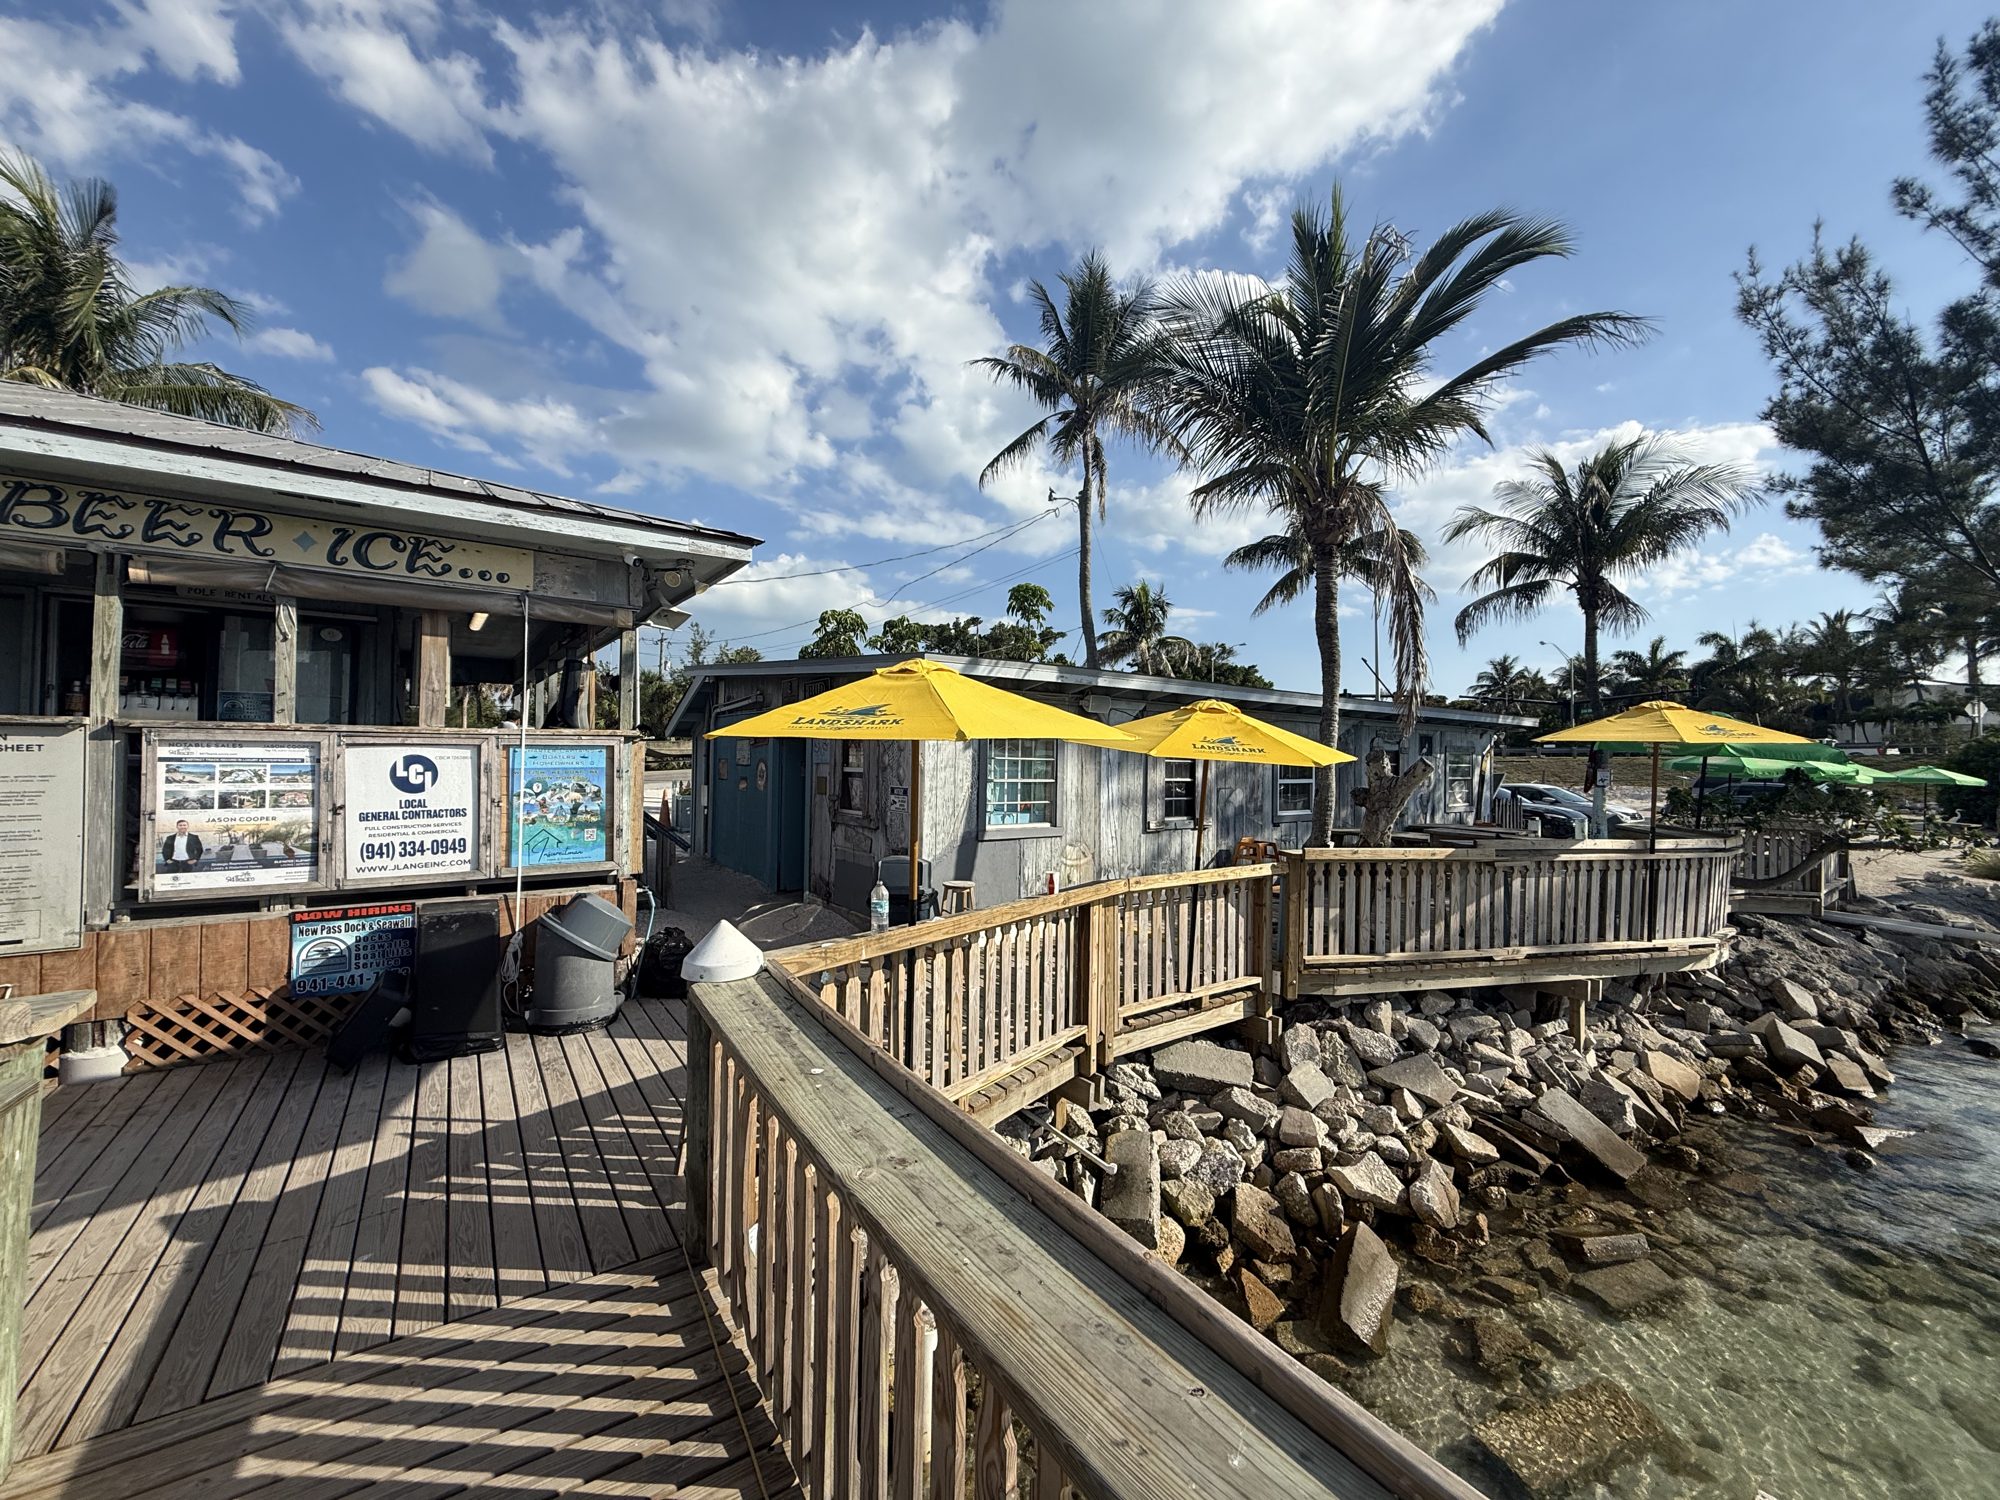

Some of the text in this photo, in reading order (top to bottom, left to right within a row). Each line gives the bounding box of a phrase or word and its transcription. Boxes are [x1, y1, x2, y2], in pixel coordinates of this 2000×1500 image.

[0, 480, 275, 557] BEER
[187, 587, 276, 603] POLE RENTALS
[791, 716, 905, 726] LANDSHARK
[0, 744, 45, 752] SHEET
[1191, 743, 1267, 754] LANDSHARK
[399, 799, 428, 809] LOCAL
[359, 808, 467, 822] GENERAL CONTRACTORS
[360, 837, 467, 862] (941) 334-0949
[355, 859, 471, 873] WWW.JLANGEINC.COM
[294, 904, 413, 922] NOW HIRING
[297, 916, 413, 937] New Pass Dock & Seawall
[354, 932, 392, 943] Docks
[354, 939, 410, 953] Seawalls
[354, 950, 382, 961] Boat
[353, 958, 401, 970] Service
